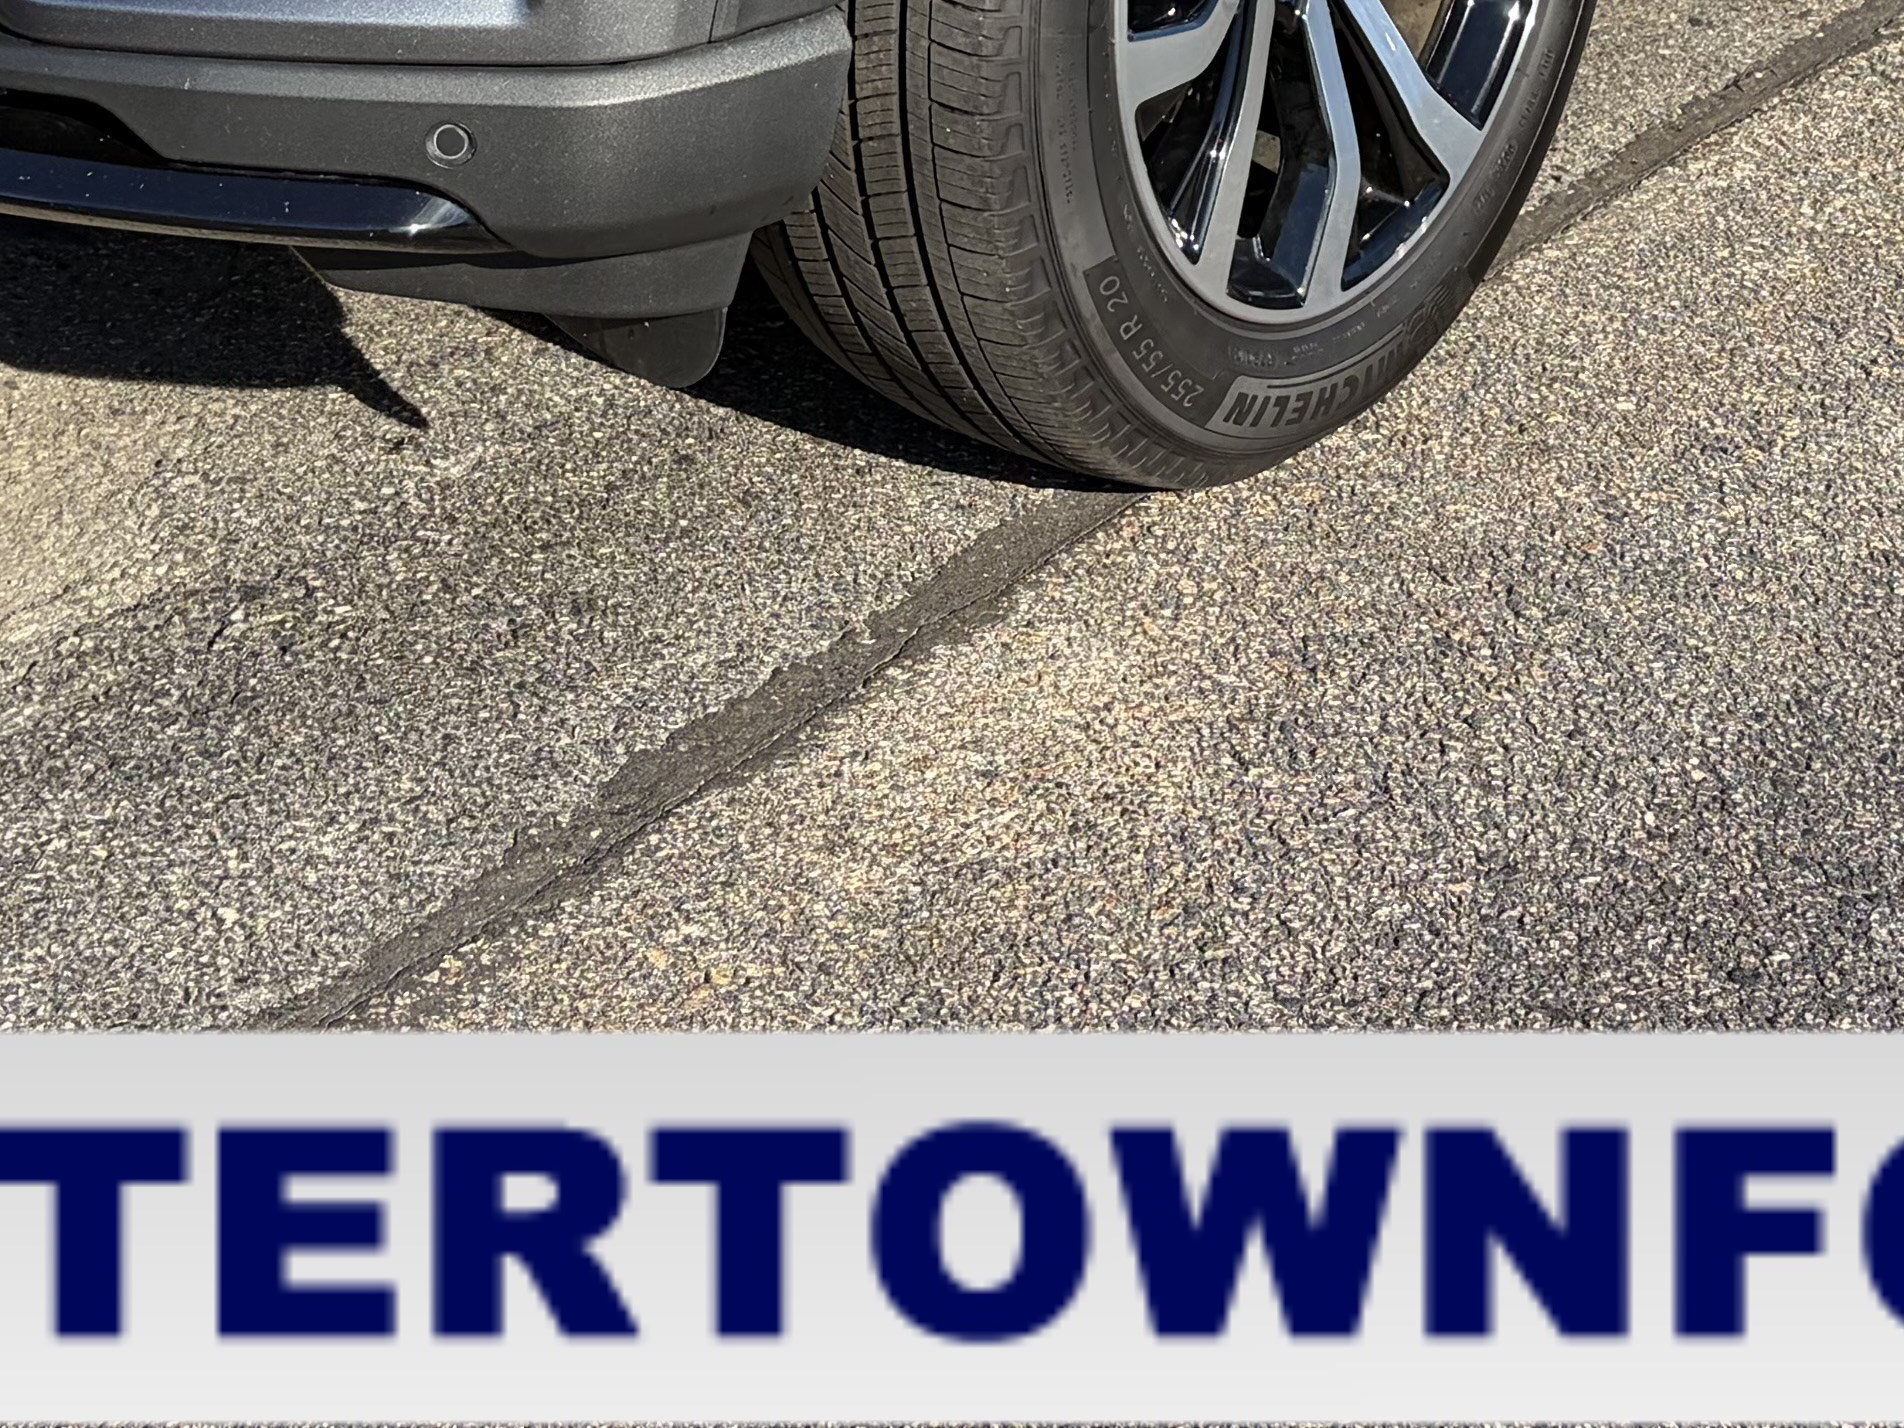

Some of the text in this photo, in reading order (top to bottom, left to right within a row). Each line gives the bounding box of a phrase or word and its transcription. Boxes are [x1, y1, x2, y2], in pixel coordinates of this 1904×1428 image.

[1099, 275, 1129, 313] 20
[1119, 314, 1143, 341] R
[1132, 338, 1205, 407] 255/55
[1222, 342, 1404, 428] MICHELIN
